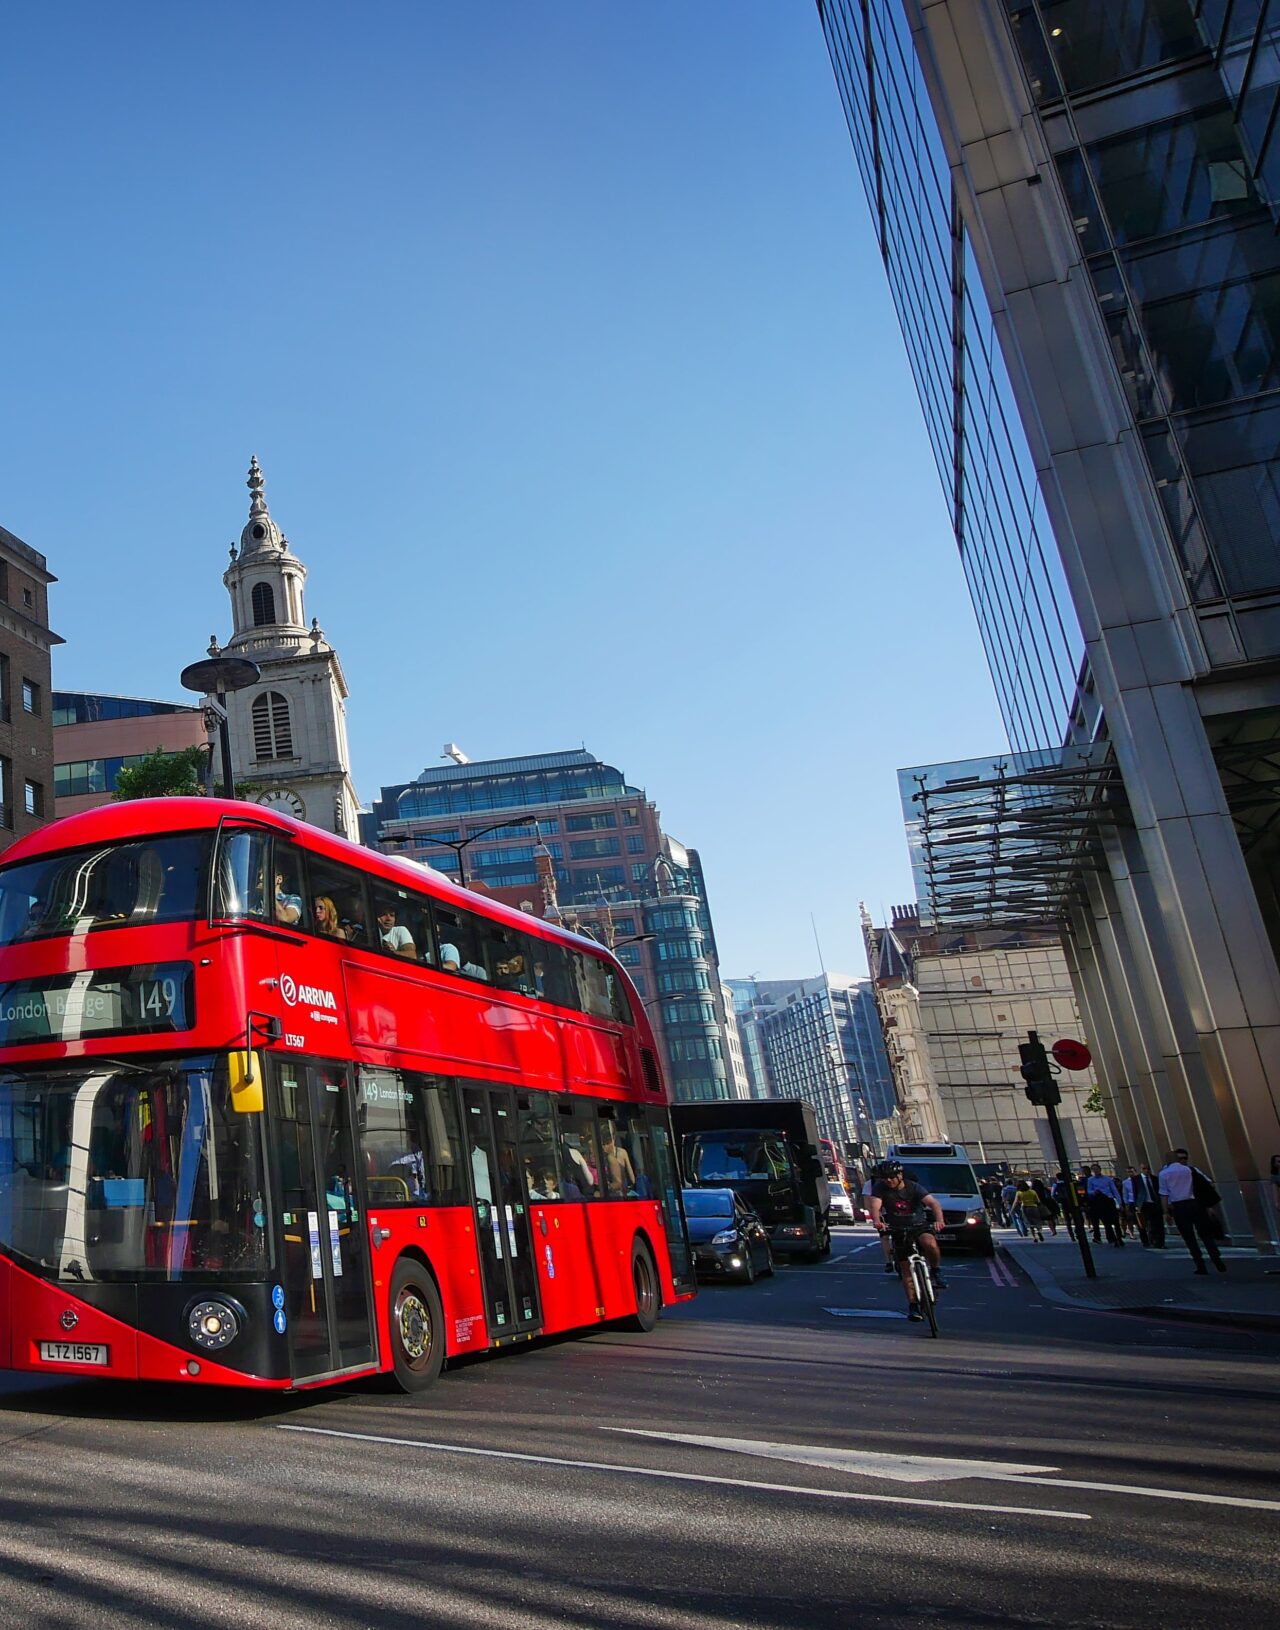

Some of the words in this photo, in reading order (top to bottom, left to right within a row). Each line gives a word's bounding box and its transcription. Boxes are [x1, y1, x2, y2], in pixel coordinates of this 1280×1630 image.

[139, 978, 176, 1019] 149
[298, 984, 337, 1010] ARRIVA
[0, 1000, 51, 1022] London
[56, 996, 104, 1017] Bge
[285, 1033, 305, 1048] LT567
[363, 1081, 378, 1101] 149
[379, 1087, 398, 1100] London
[47, 1344, 70, 1360] LTZ
[73, 1345, 99, 1361] 1567
